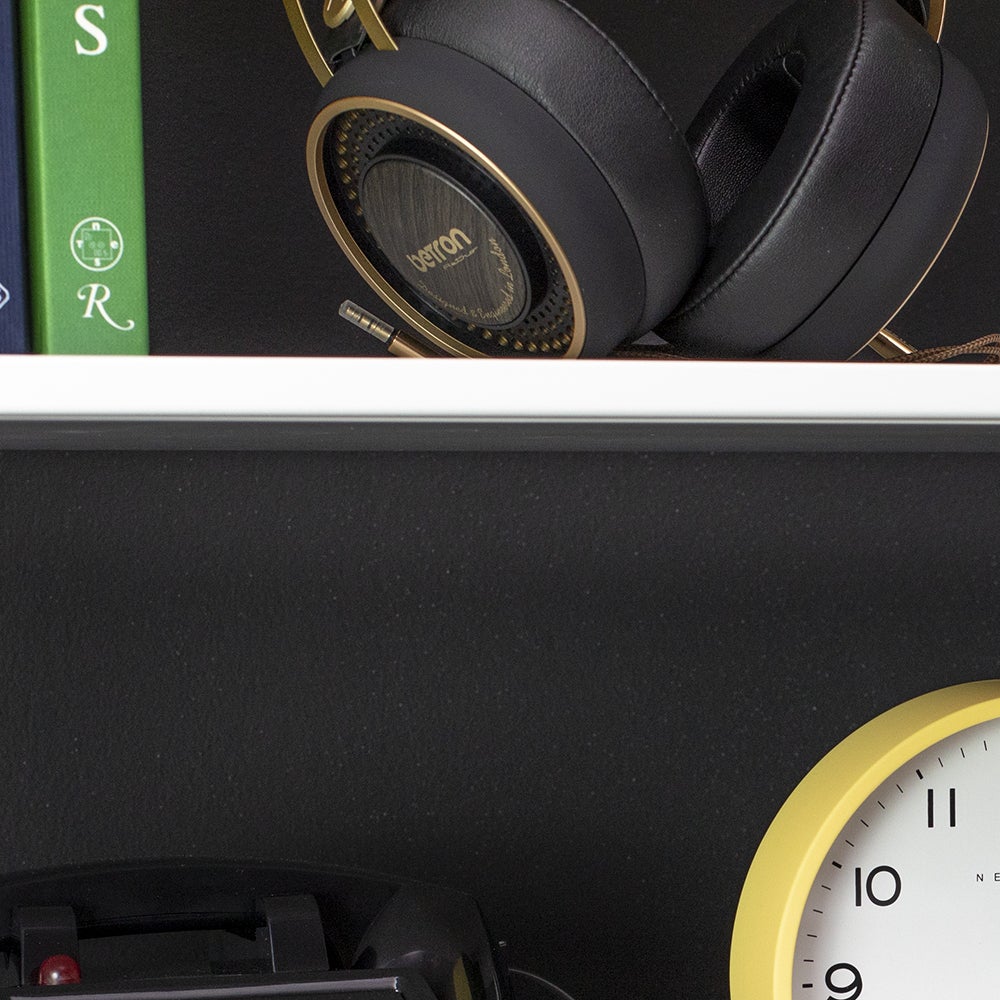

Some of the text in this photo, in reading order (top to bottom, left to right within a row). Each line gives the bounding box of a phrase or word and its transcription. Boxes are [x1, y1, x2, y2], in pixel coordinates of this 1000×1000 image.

[74, 4, 108, 56] S
[76, 282, 136, 332] R
[927, 787, 956, 828] 11
[854, 865, 902, 907] 10
